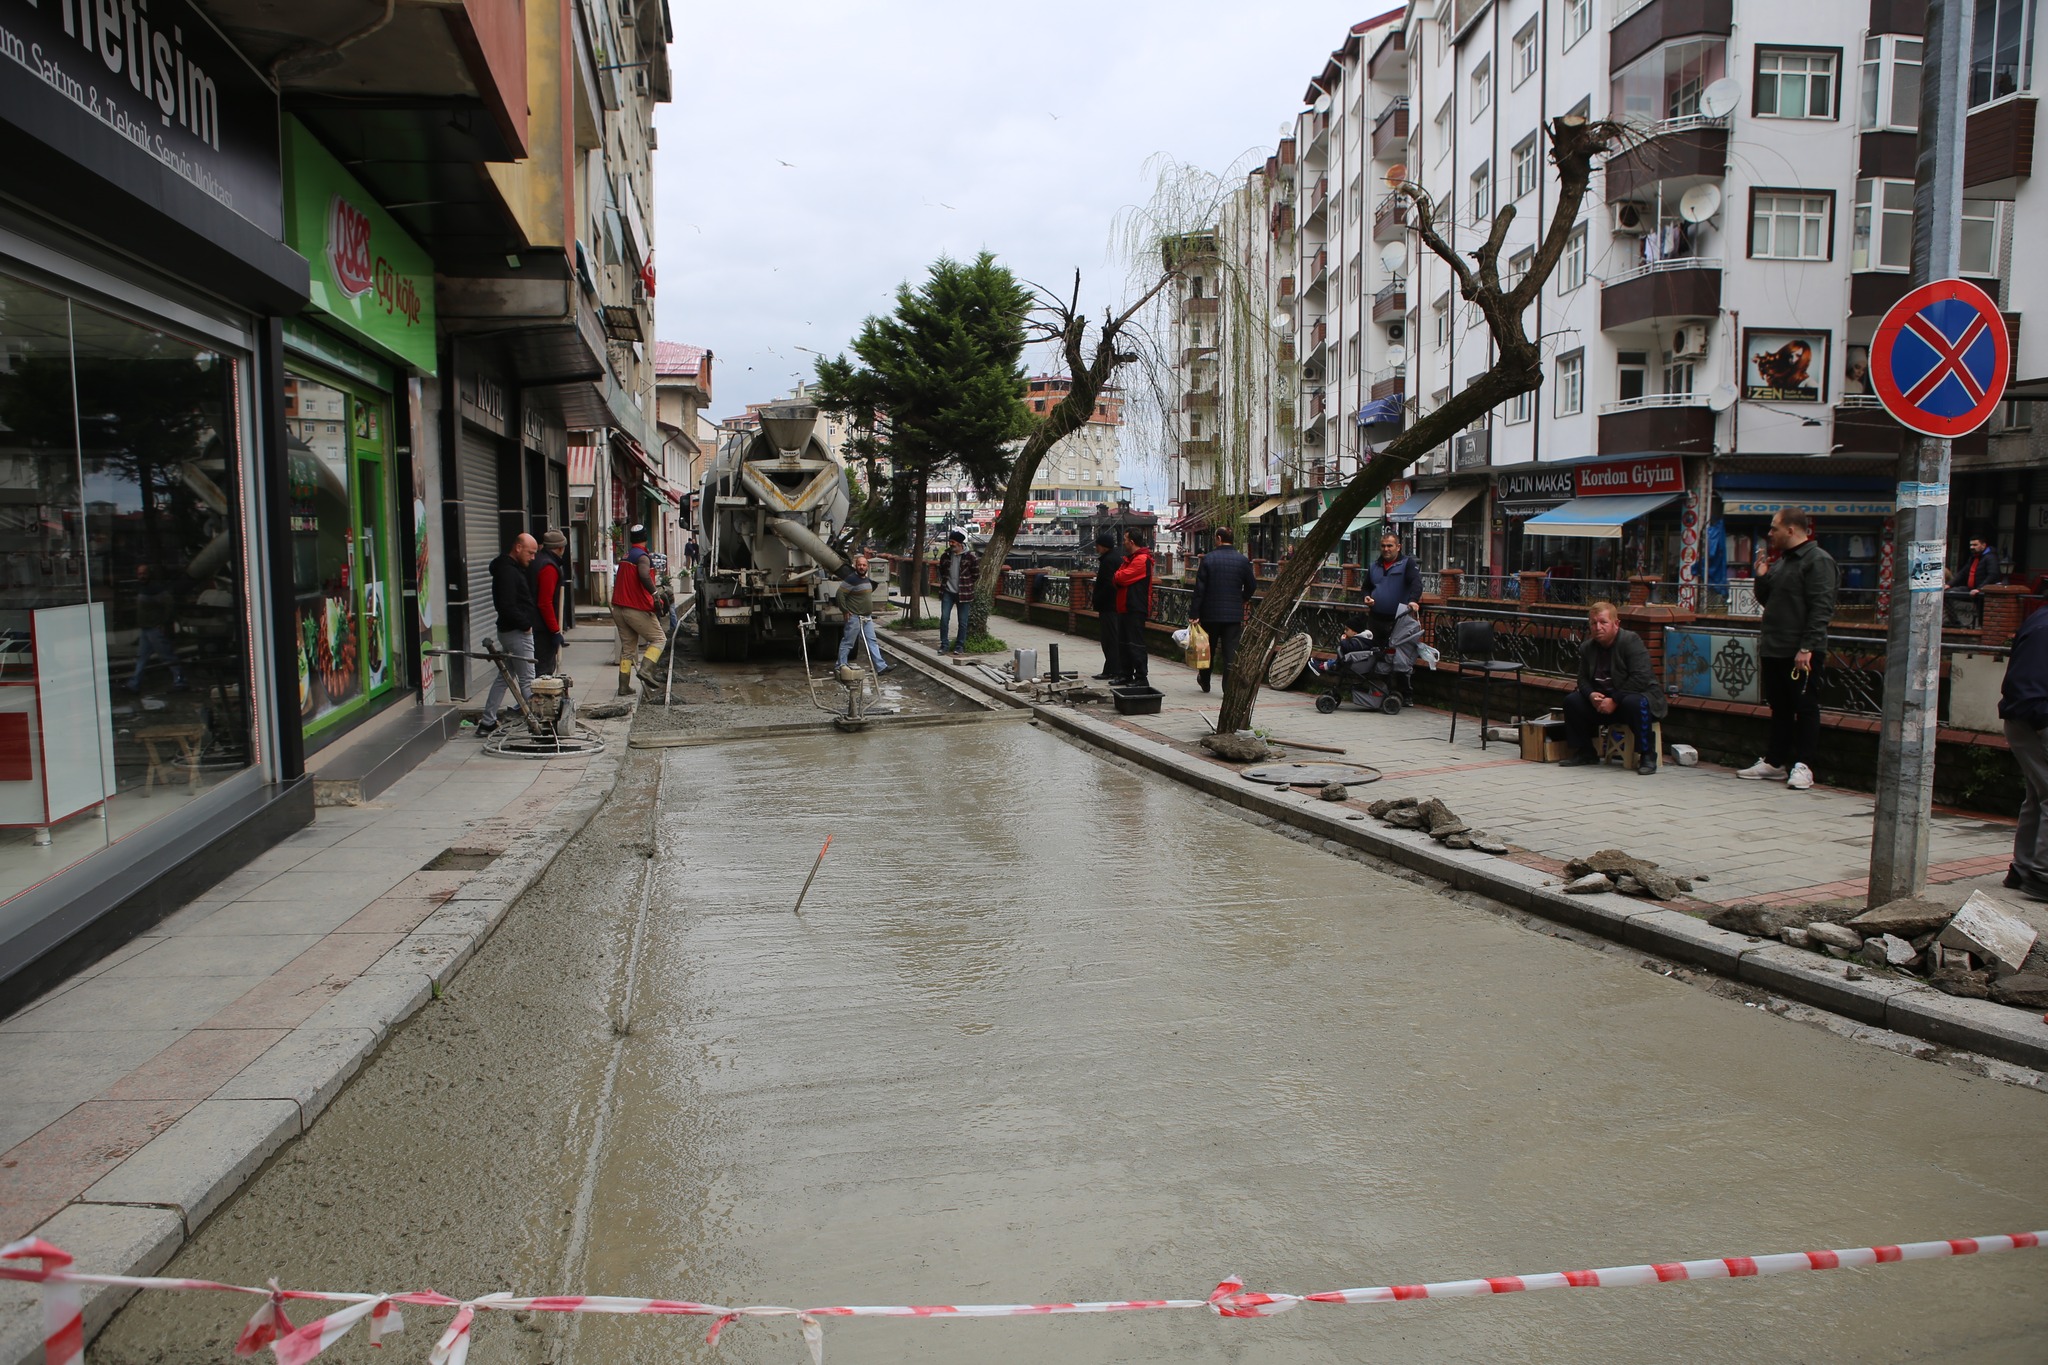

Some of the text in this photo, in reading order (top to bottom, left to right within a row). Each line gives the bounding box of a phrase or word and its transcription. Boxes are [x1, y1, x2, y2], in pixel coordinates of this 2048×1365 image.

[32, 43, 84, 105] Satım
[89, 85, 102, 116] &
[106, 97, 151, 151] Teknik
[155, 134, 192, 180] Servis
[194, 162, 232, 207] Noktası
[375, 256, 421, 327] Çiğ köfte
[478, 373, 504, 421] KOTİL
[1751, 387, 1783, 400] ZEN
[1509, 473, 1572, 493] ALTIN MAKAS
[1581, 464, 1674, 488] Kordon Giyim
[1739, 504, 1827, 513] KORON
